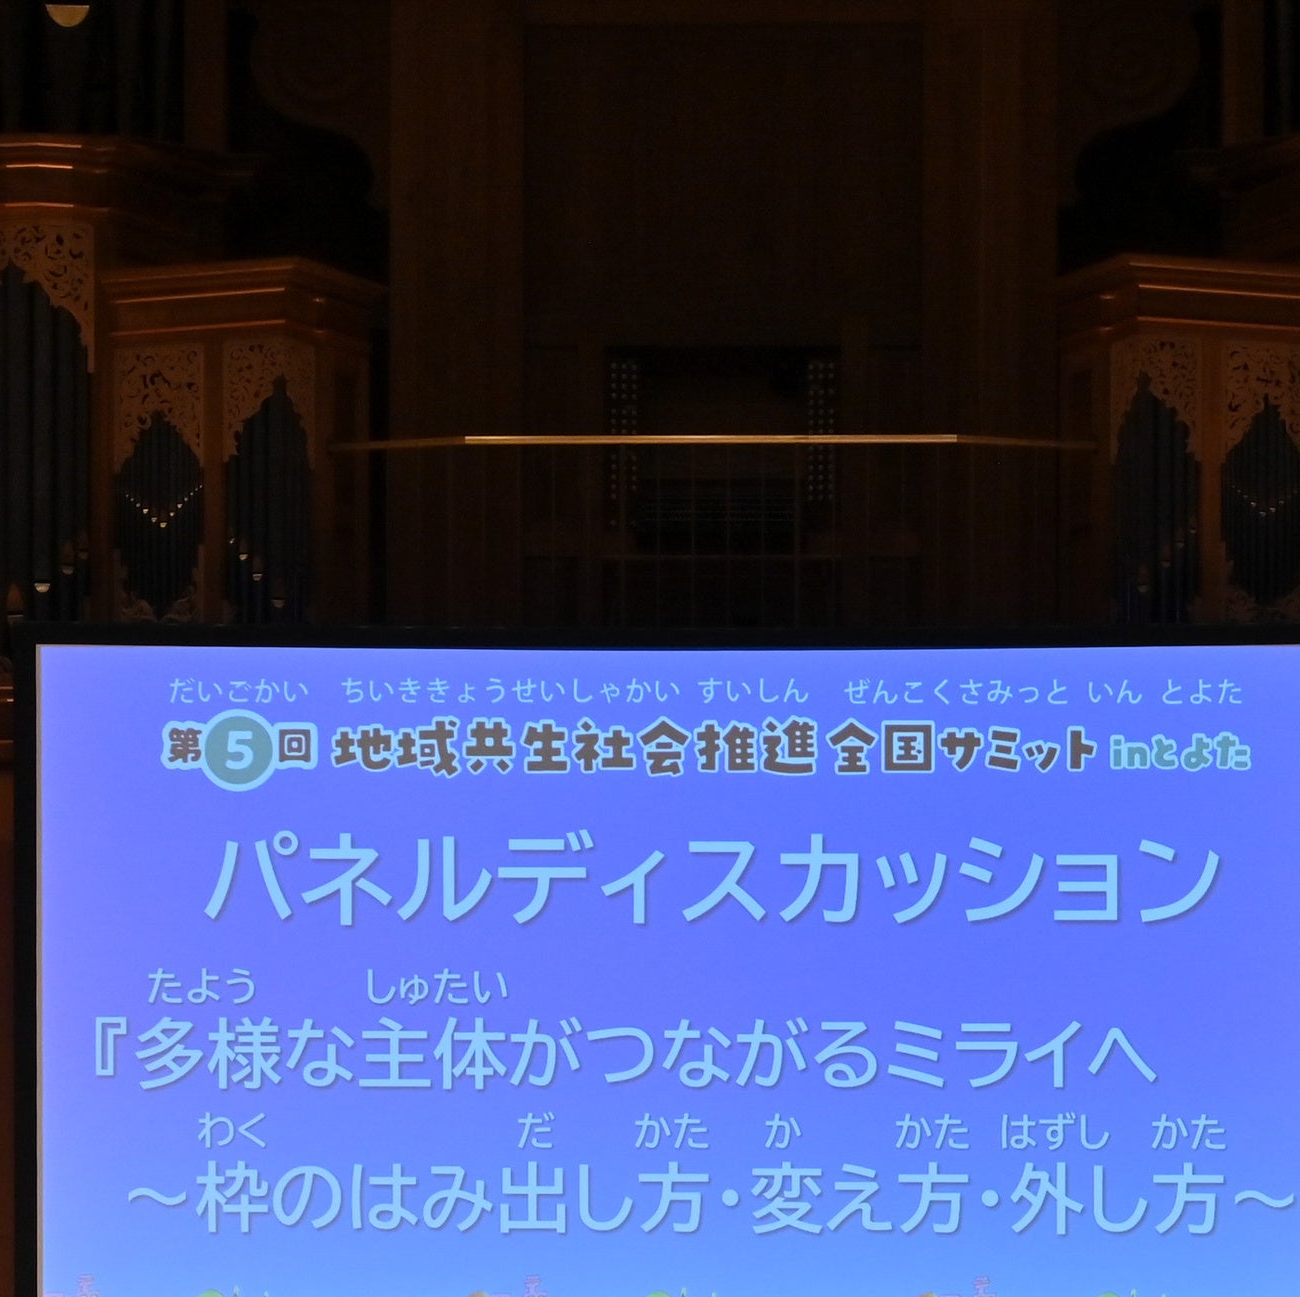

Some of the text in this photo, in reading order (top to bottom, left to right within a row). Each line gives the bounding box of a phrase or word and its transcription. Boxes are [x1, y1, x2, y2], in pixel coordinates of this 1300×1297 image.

[169, 678, 1242, 704] だいごかい ちいききょうせいしゃかい すいしん ぜんこくさみっと いん とよた
[161, 709, 318, 791] 第5回
[203, 830, 1220, 925] パネルディスカッション
[147, 968, 508, 1004] たよう しゅたい
[95, 1017, 1157, 1089] 『多様な主体がつながるミライへ
[197, 1112, 1226, 1149] わく だ かた か かた はずし かた
